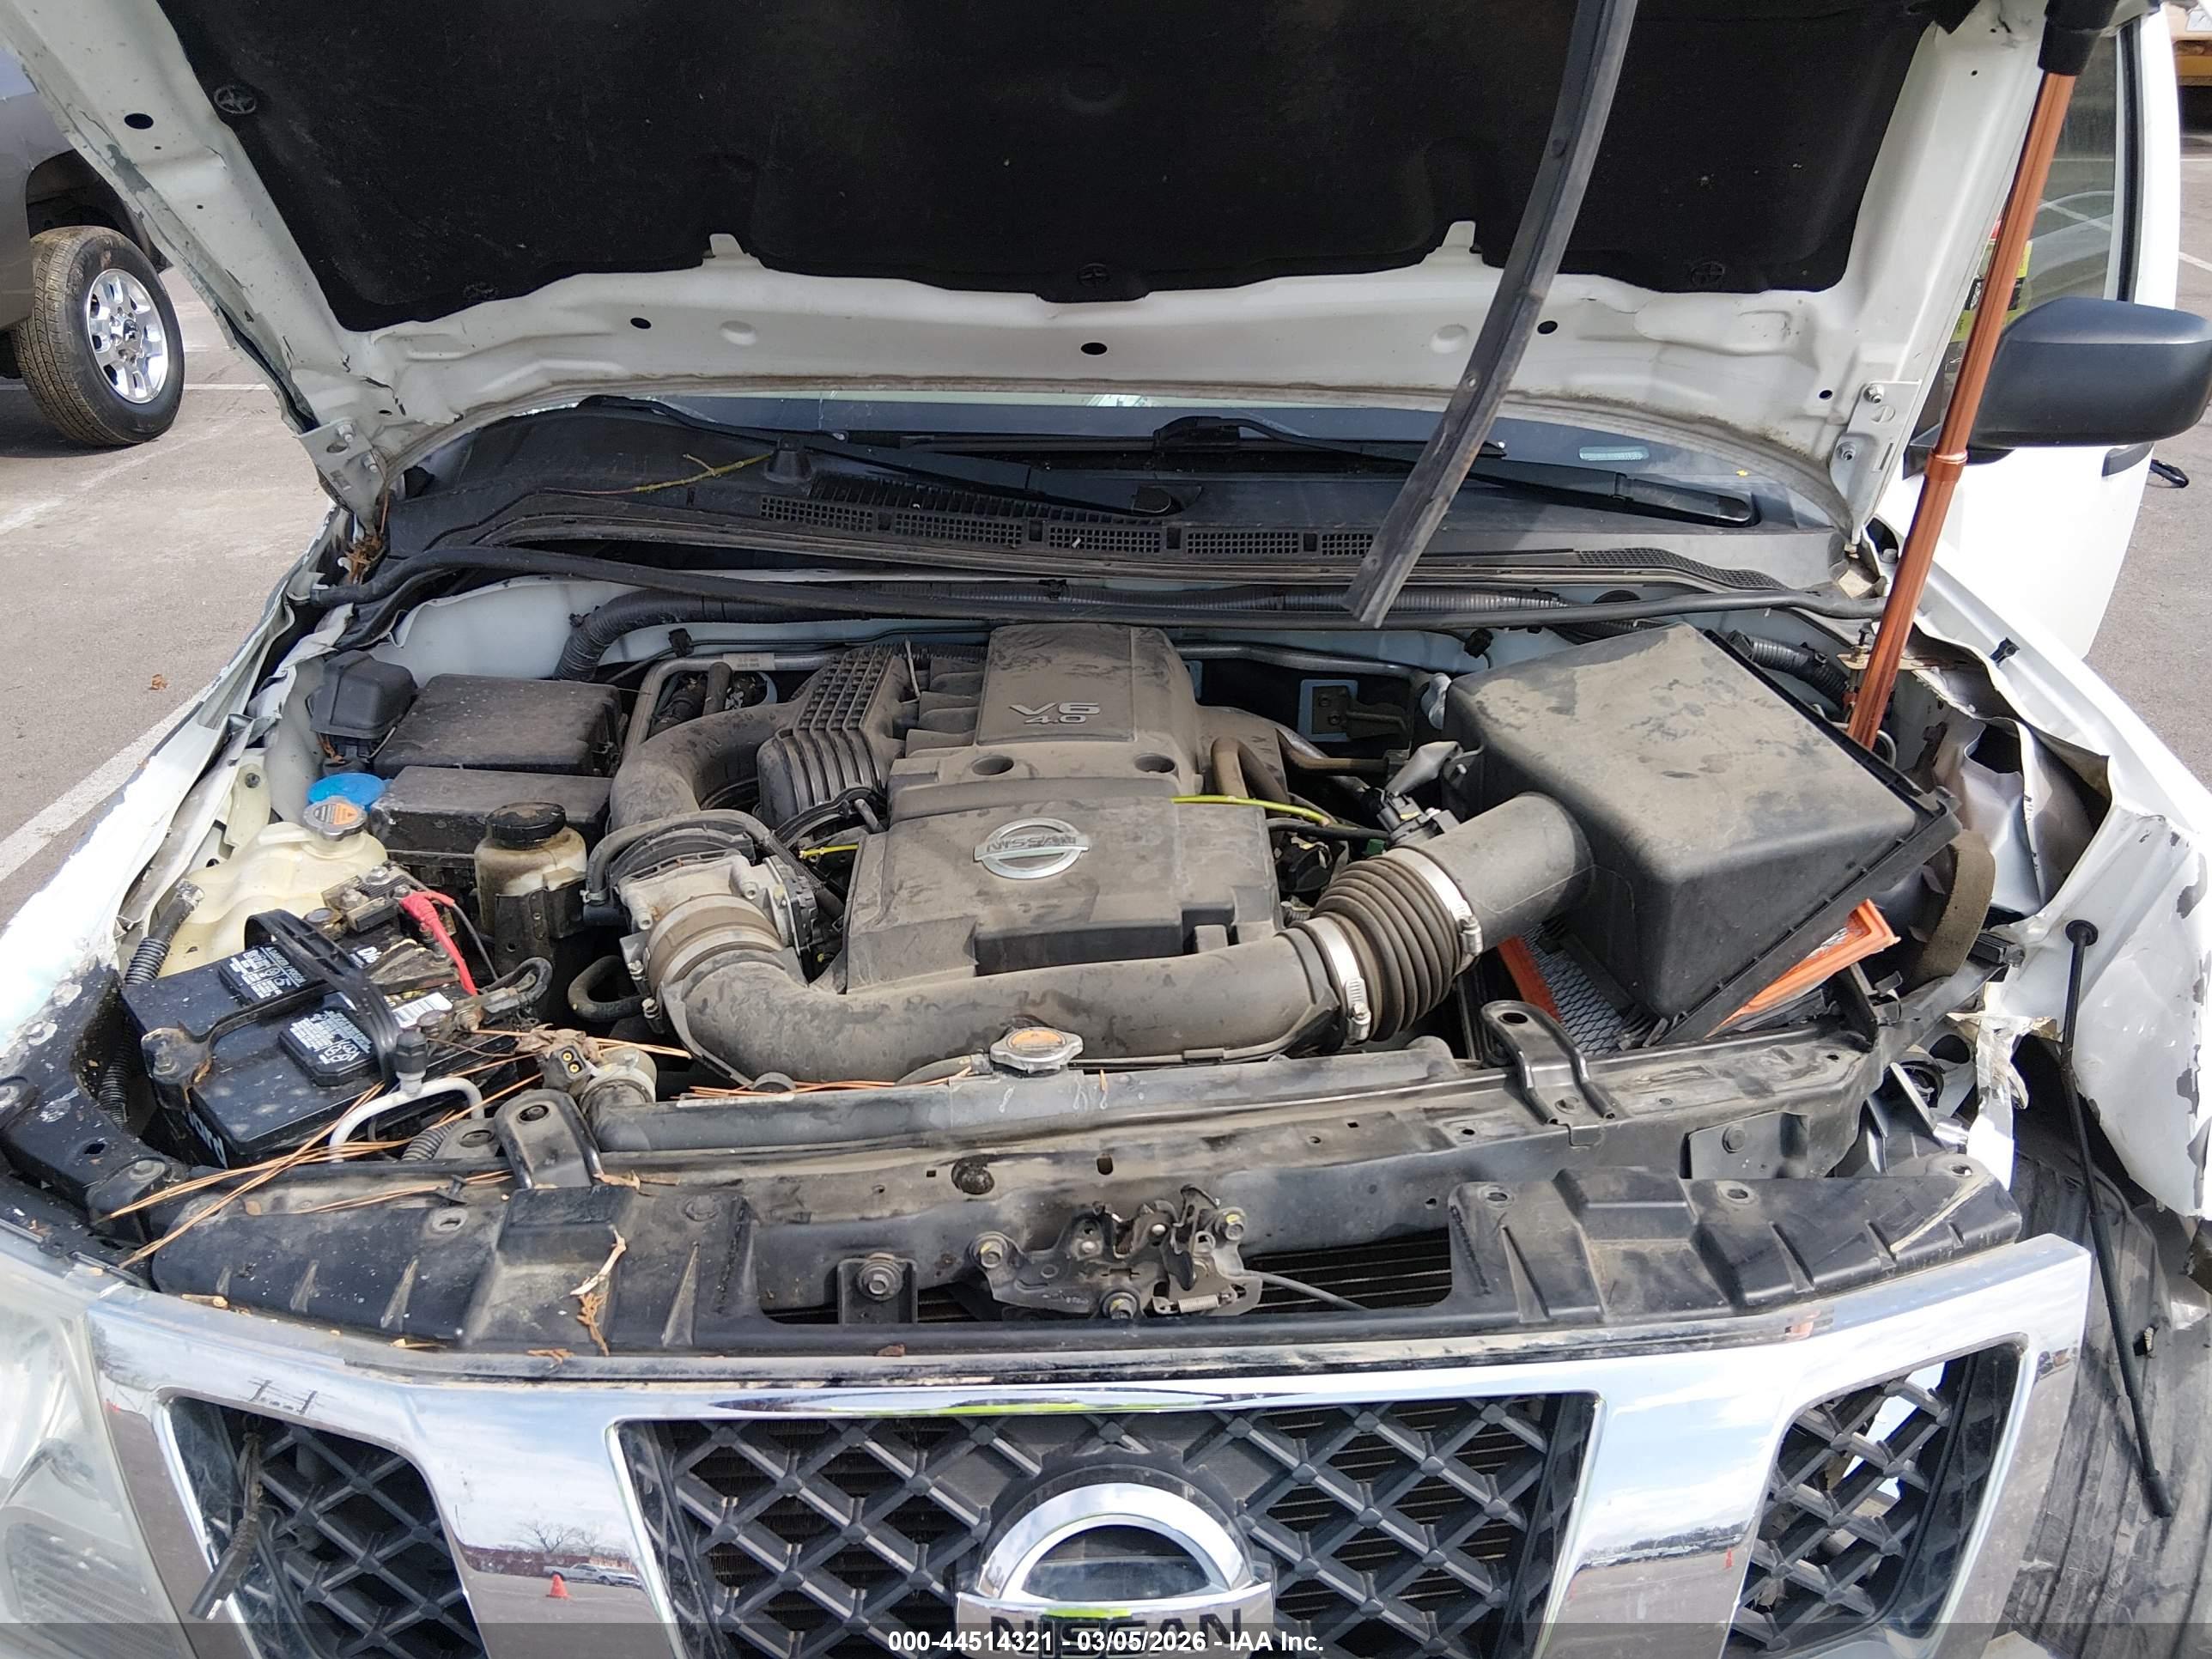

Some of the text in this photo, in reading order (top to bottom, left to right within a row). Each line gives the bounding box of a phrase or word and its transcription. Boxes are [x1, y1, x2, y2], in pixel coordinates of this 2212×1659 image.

[1009, 701, 1100, 716] V6
[1024, 714, 1086, 725] 4.0
[987, 835, 1077, 853] NISSAN
[990, 1607, 1242, 1657] NISSAN
